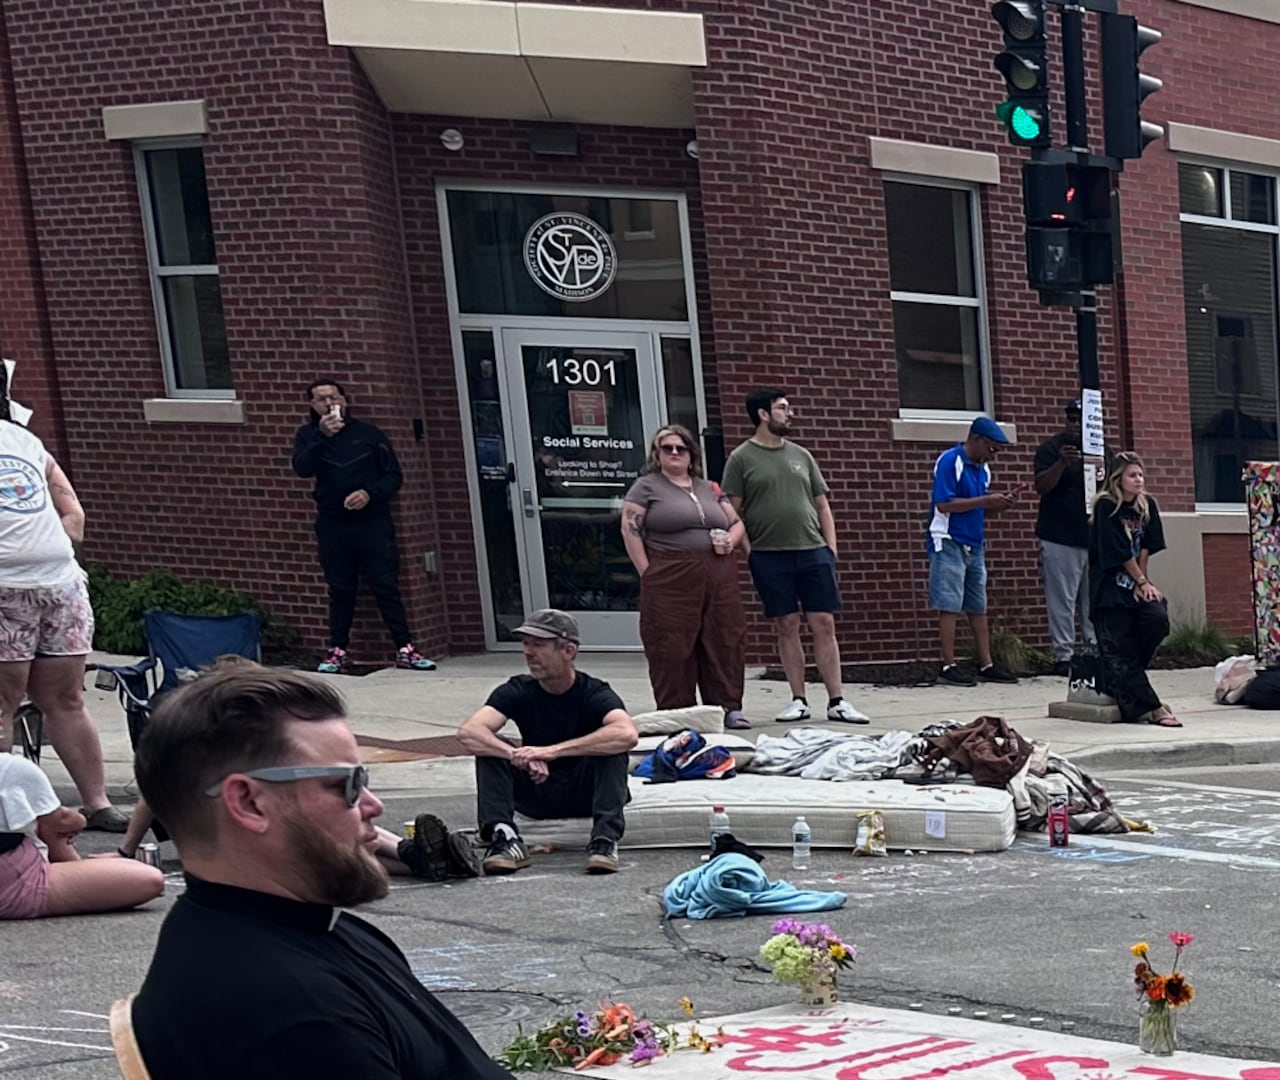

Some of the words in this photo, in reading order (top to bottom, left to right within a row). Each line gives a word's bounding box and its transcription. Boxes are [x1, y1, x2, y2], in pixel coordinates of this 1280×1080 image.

[546, 358, 617, 387] 1301
[543, 436, 580, 448] Social
[583, 437, 634, 450] Services
[558, 461, 587, 469] Looking
[589, 461, 598, 469] to
